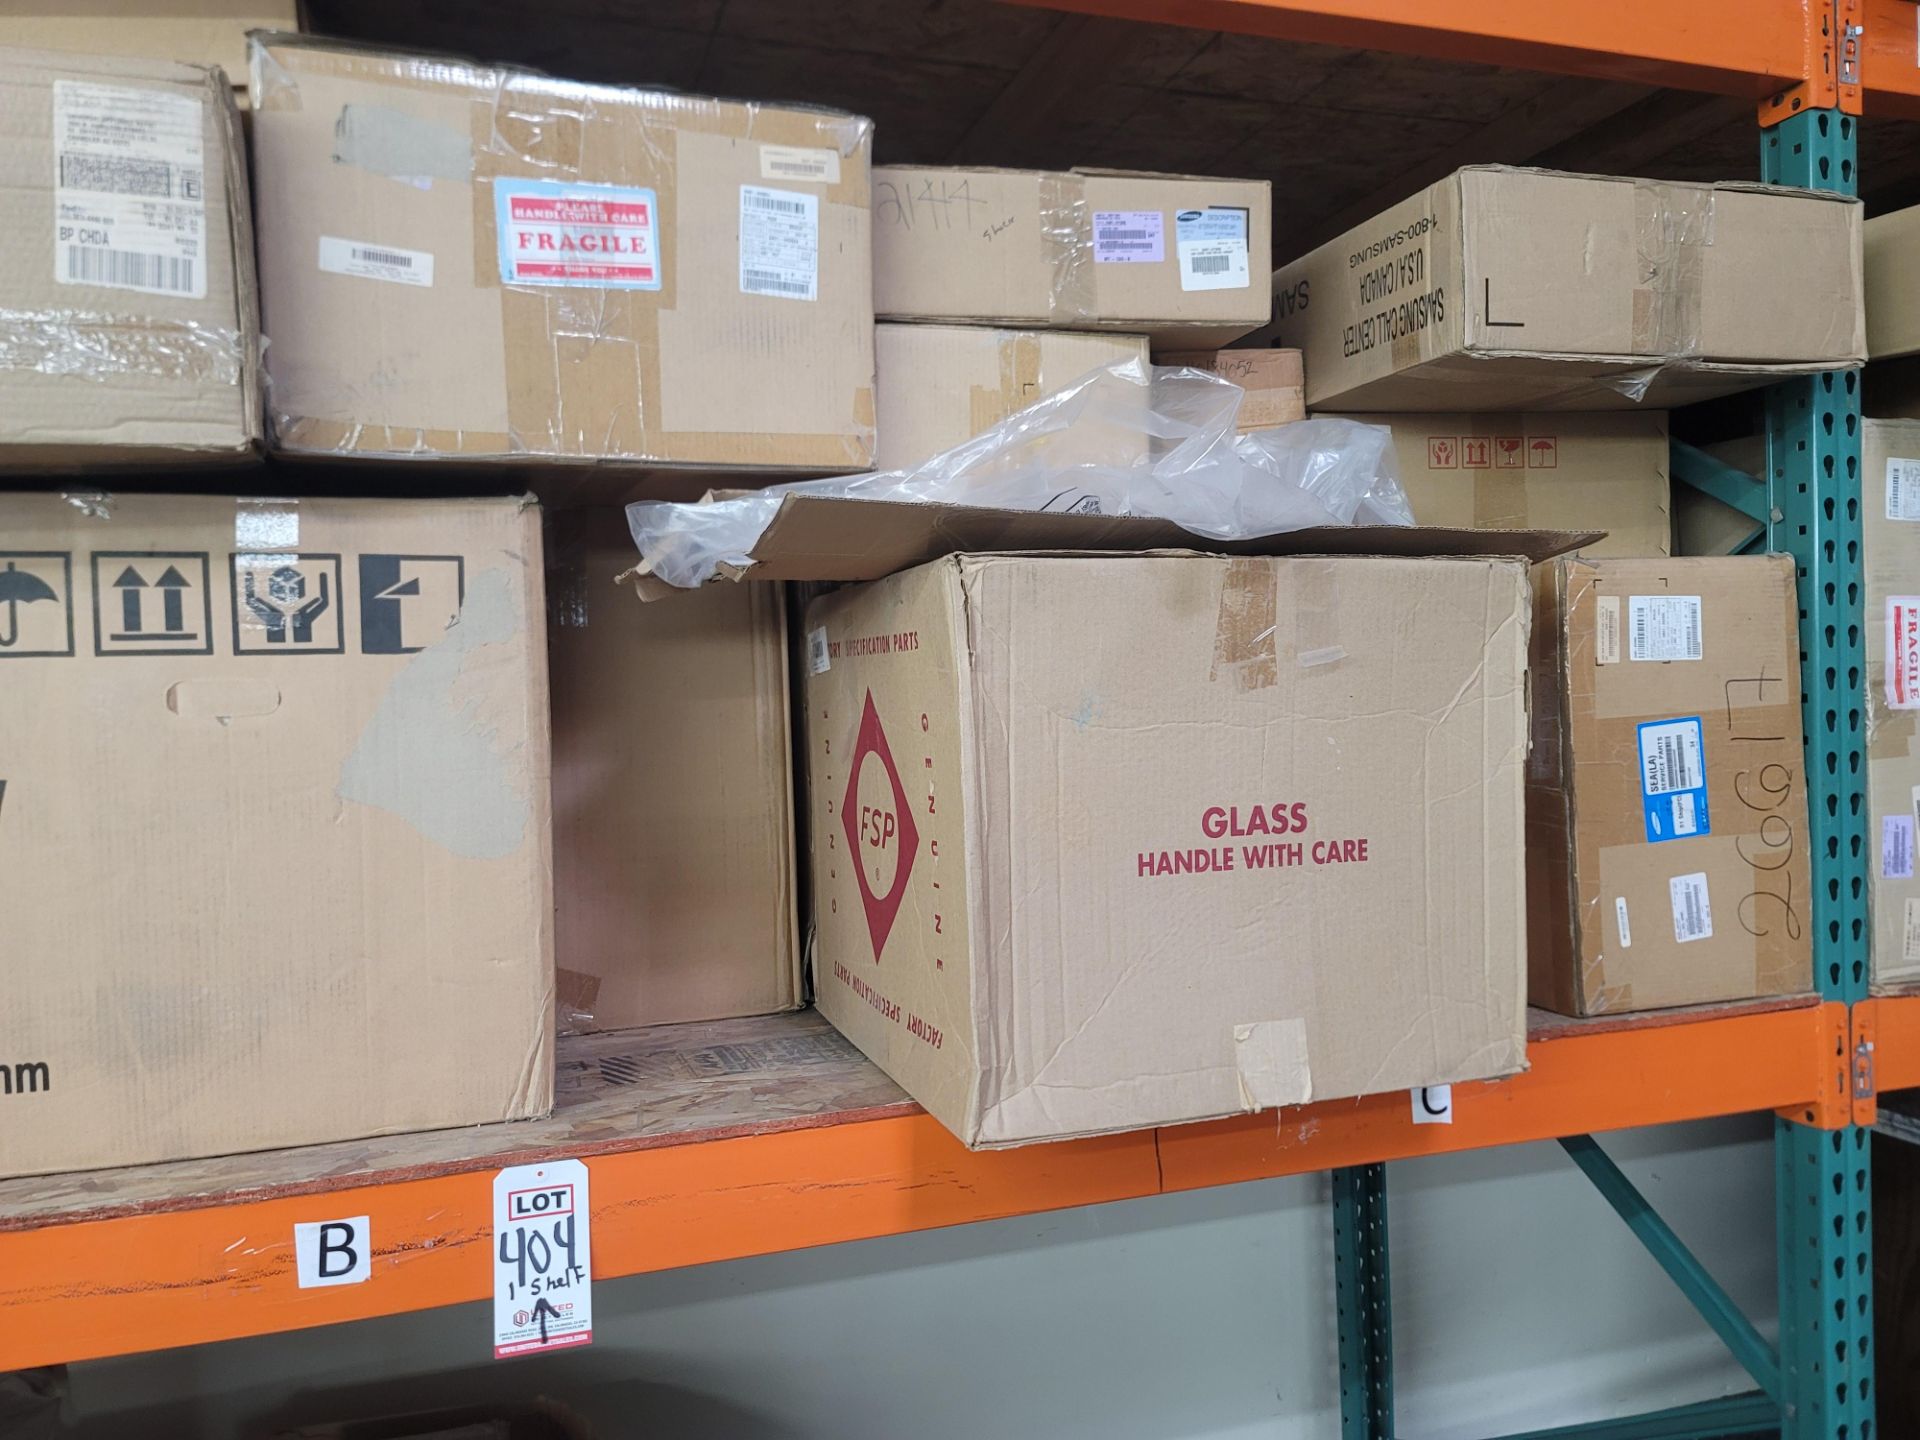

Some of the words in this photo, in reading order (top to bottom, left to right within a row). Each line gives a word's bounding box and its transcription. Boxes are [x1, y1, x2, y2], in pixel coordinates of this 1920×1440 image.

[573, 211, 609, 223] WITH
[612, 213, 646, 224] CARE
[517, 231, 646, 255] FRAGILE
[1350, 214, 1438, 269] 1-800-SAMSUNG
[1376, 307, 1398, 345] CALL
[1400, 287, 1444, 337] SAMSUNG
[1342, 316, 1376, 358] CENTER
[846, 635, 891, 657] SPECIFICATION
[893, 631, 919, 653] PARTS
[1907, 607, 1919, 699] FRAGILE
[1648, 754, 1660, 793] SEA(LA)
[860, 806, 895, 849] FSP
[1201, 802, 1308, 839] GLASS
[1138, 847, 1234, 877] HANDLE
[1242, 842, 1303, 870] WITH
[1311, 838, 1368, 865] CARE
[834, 960, 851, 986] PARTS
[852, 974, 901, 1024] SPECIFICATION
[906, 1012, 943, 1050] FACTORY
[516, 1190, 567, 1214] LOT
[319, 1223, 358, 1278] B
[500, 1214, 576, 1288] 404
